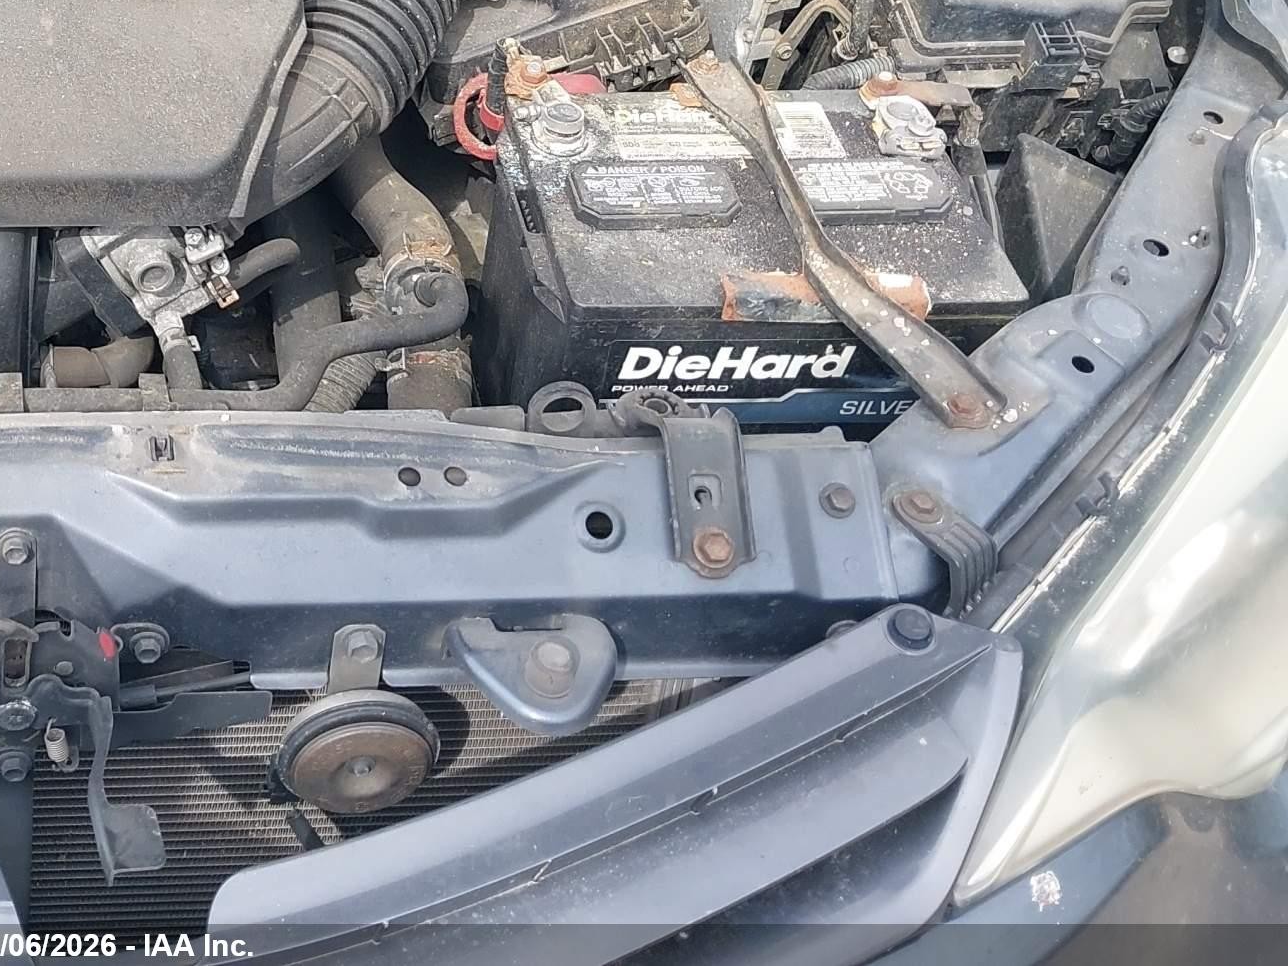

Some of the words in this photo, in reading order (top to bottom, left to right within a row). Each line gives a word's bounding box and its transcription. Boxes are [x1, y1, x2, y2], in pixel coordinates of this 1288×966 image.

[598, 166, 649, 174] DANGER
[661, 165, 706, 173] POISON
[617, 344, 858, 381] DieHard
[672, 384, 730, 392] AHEAD
[839, 400, 913, 415] SILVE
